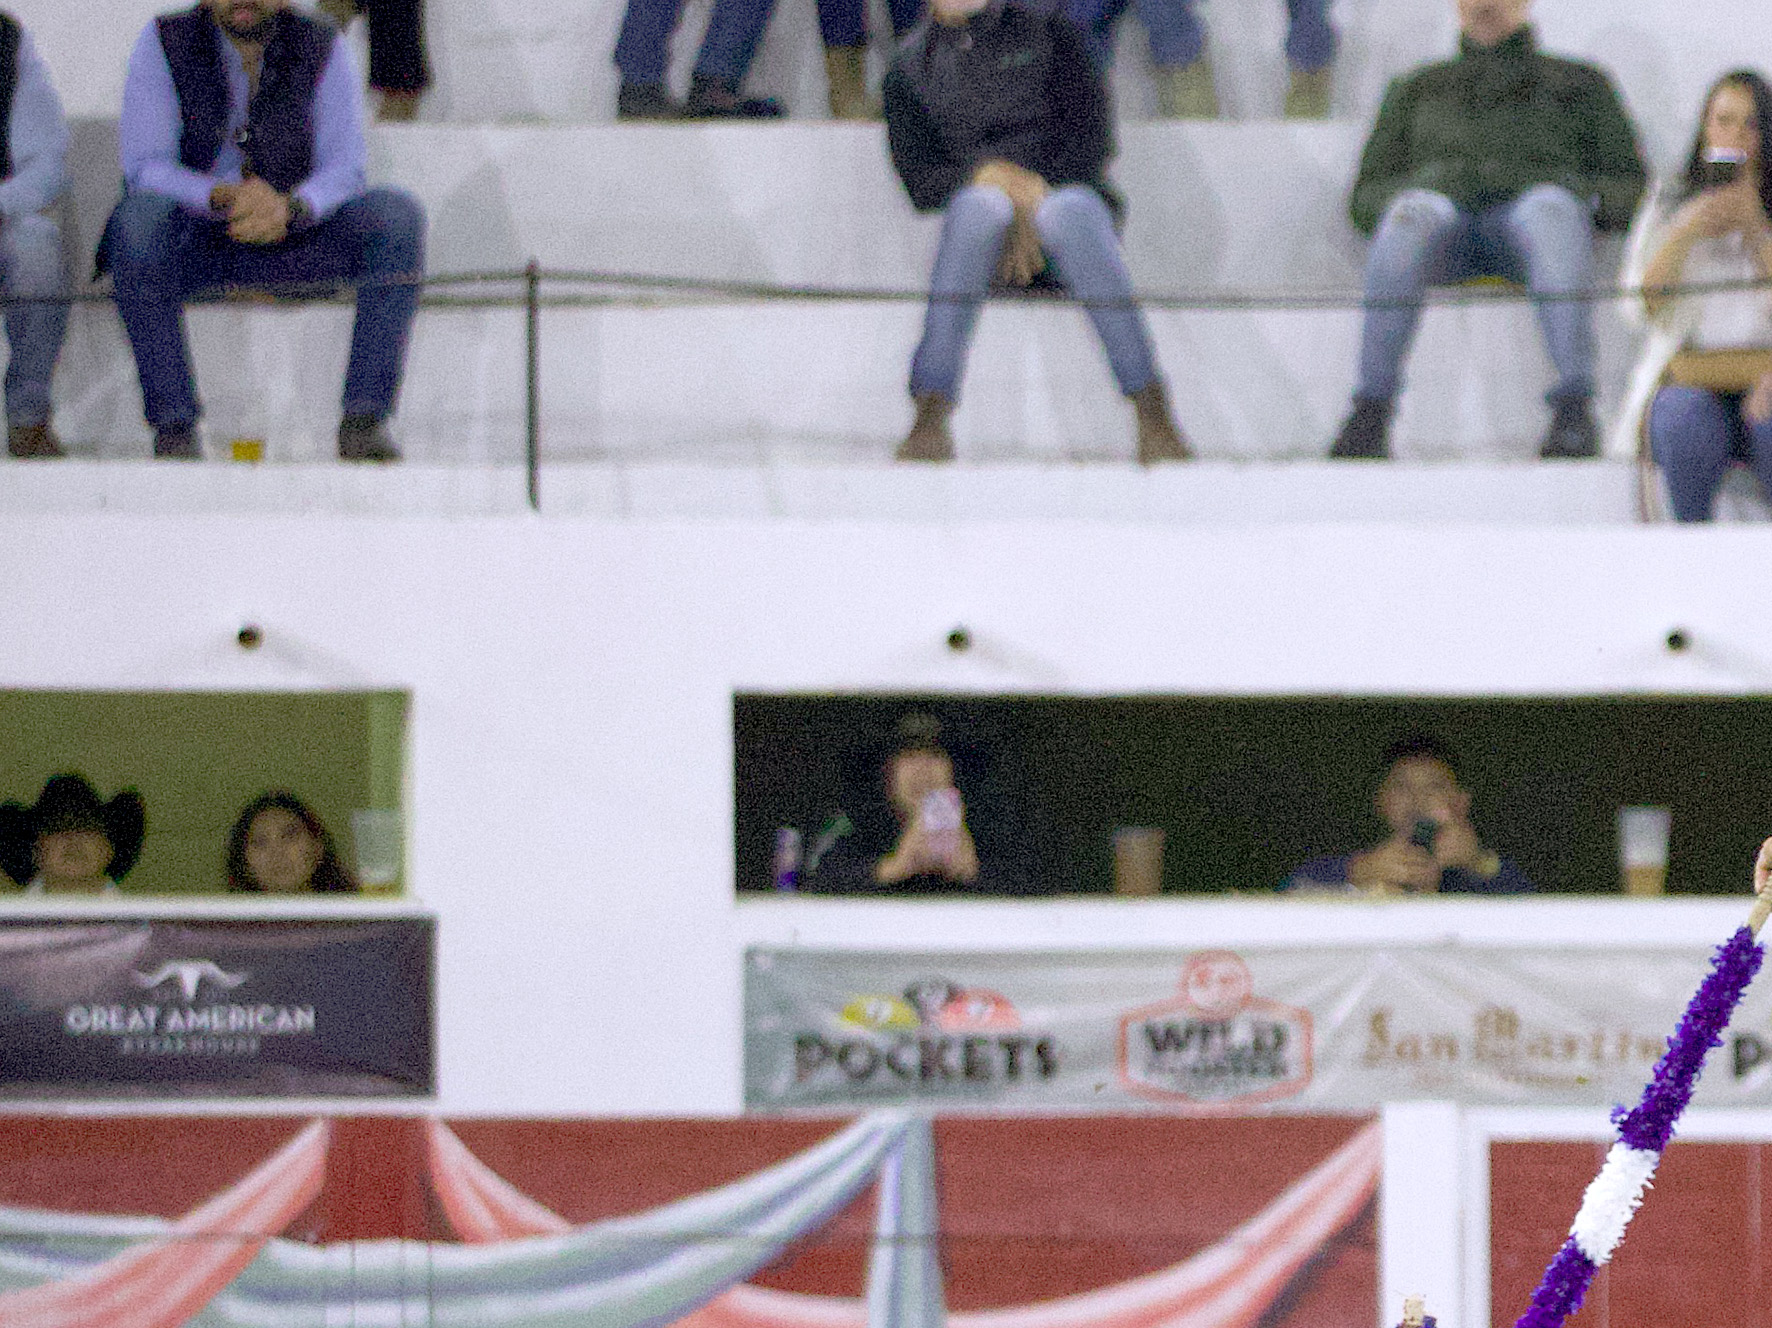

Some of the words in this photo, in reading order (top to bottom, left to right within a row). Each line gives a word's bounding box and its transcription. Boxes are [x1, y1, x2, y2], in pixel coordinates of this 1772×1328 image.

[66, 1003, 160, 1033] GREAT
[167, 1003, 316, 1033] AMERICAN
[1143, 1016, 1287, 1053] WILD
[794, 1033, 1060, 1082] POCKETS
